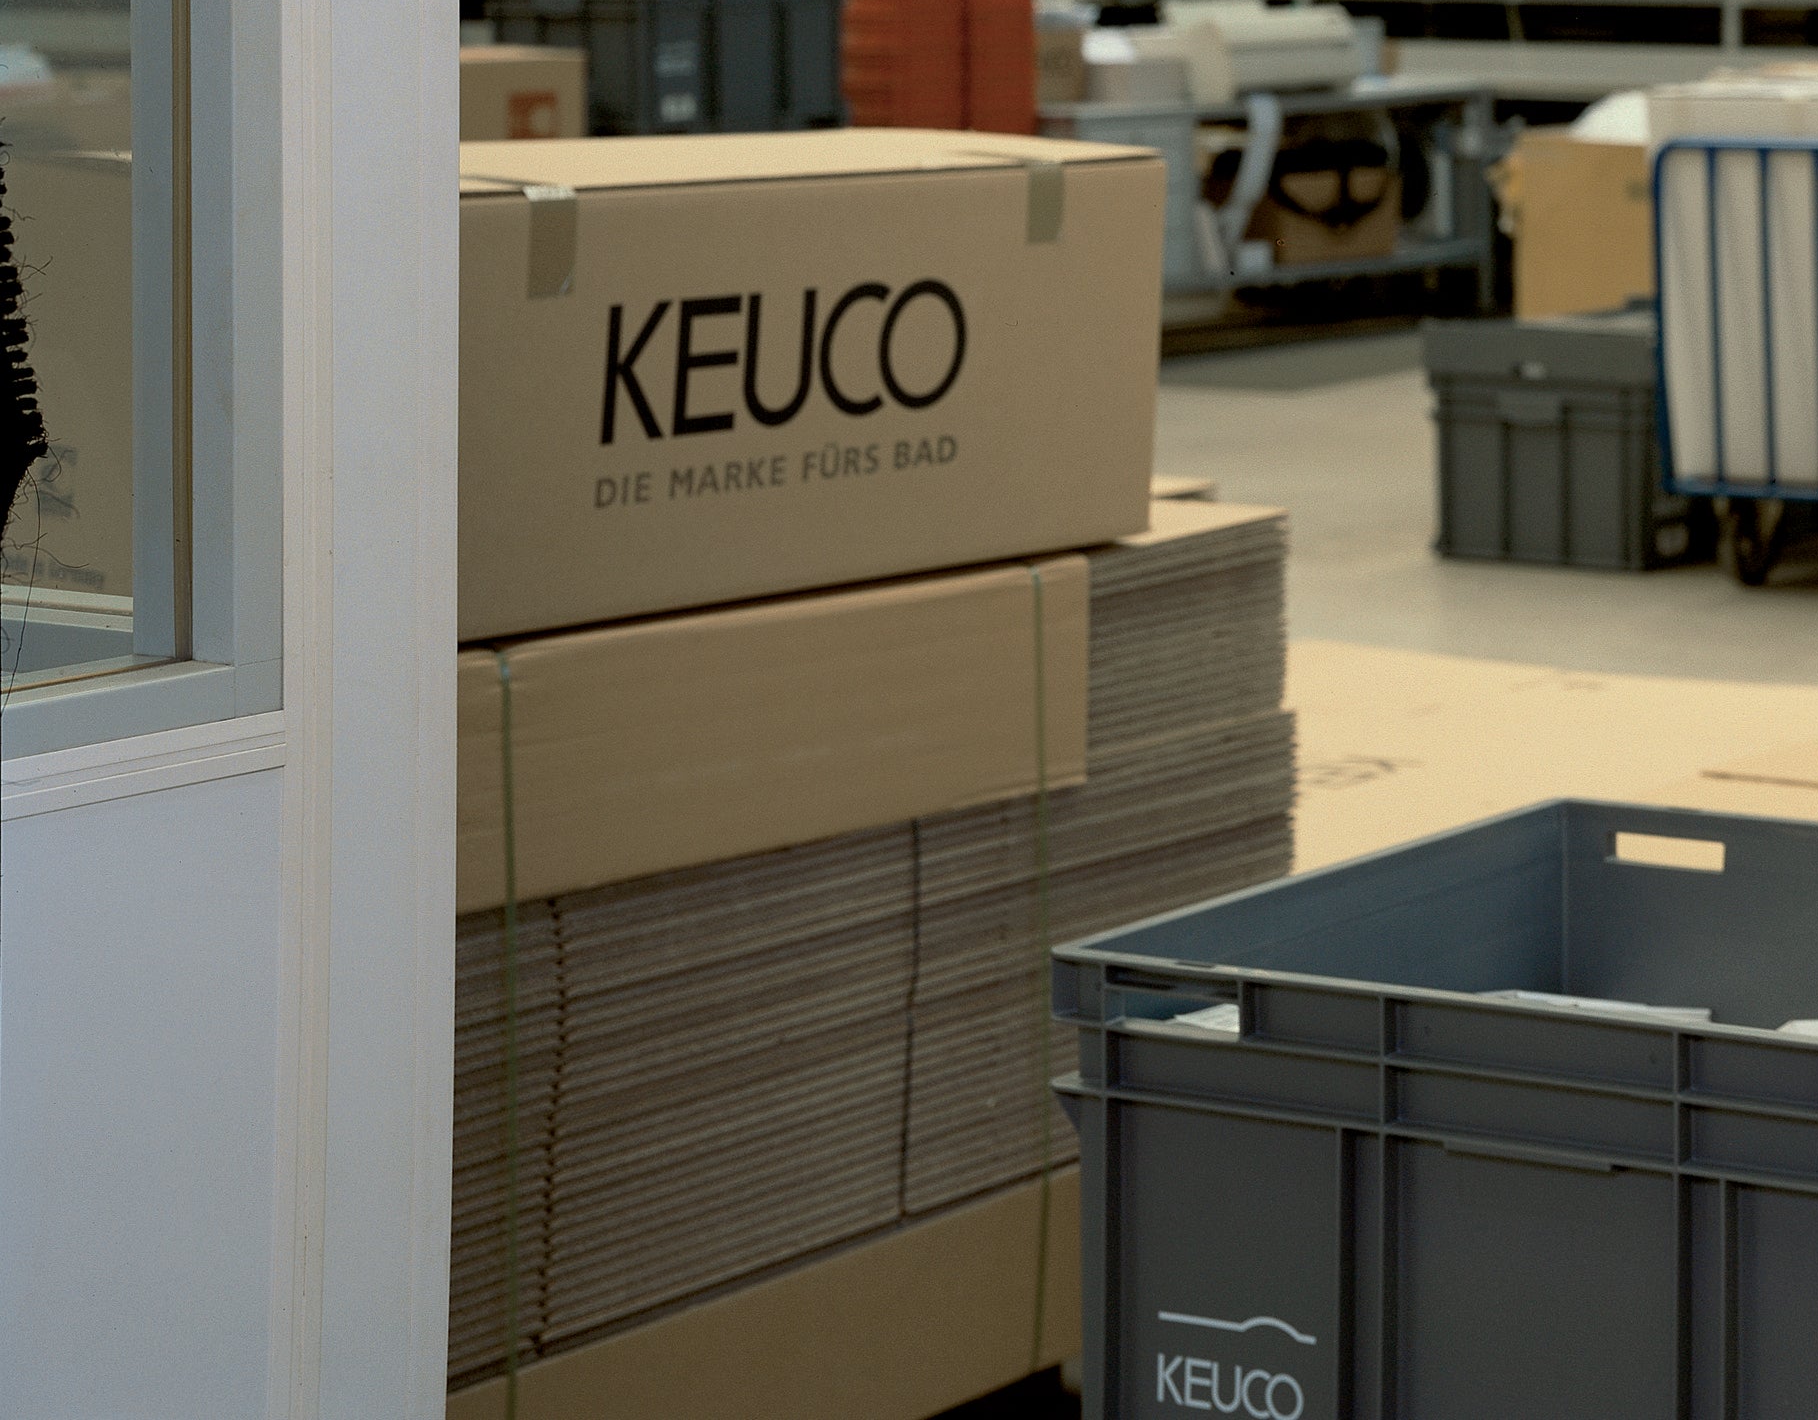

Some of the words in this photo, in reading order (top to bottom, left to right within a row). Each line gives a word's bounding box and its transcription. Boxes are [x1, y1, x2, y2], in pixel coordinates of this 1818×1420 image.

[600, 278, 968, 446] KEUCO
[594, 472, 652, 509] DIE
[667, 455, 787, 501] MARKE
[801, 443, 880, 480] FÜRS
[893, 434, 959, 471] BAD
[1156, 1352, 1305, 1420] KEUCO
